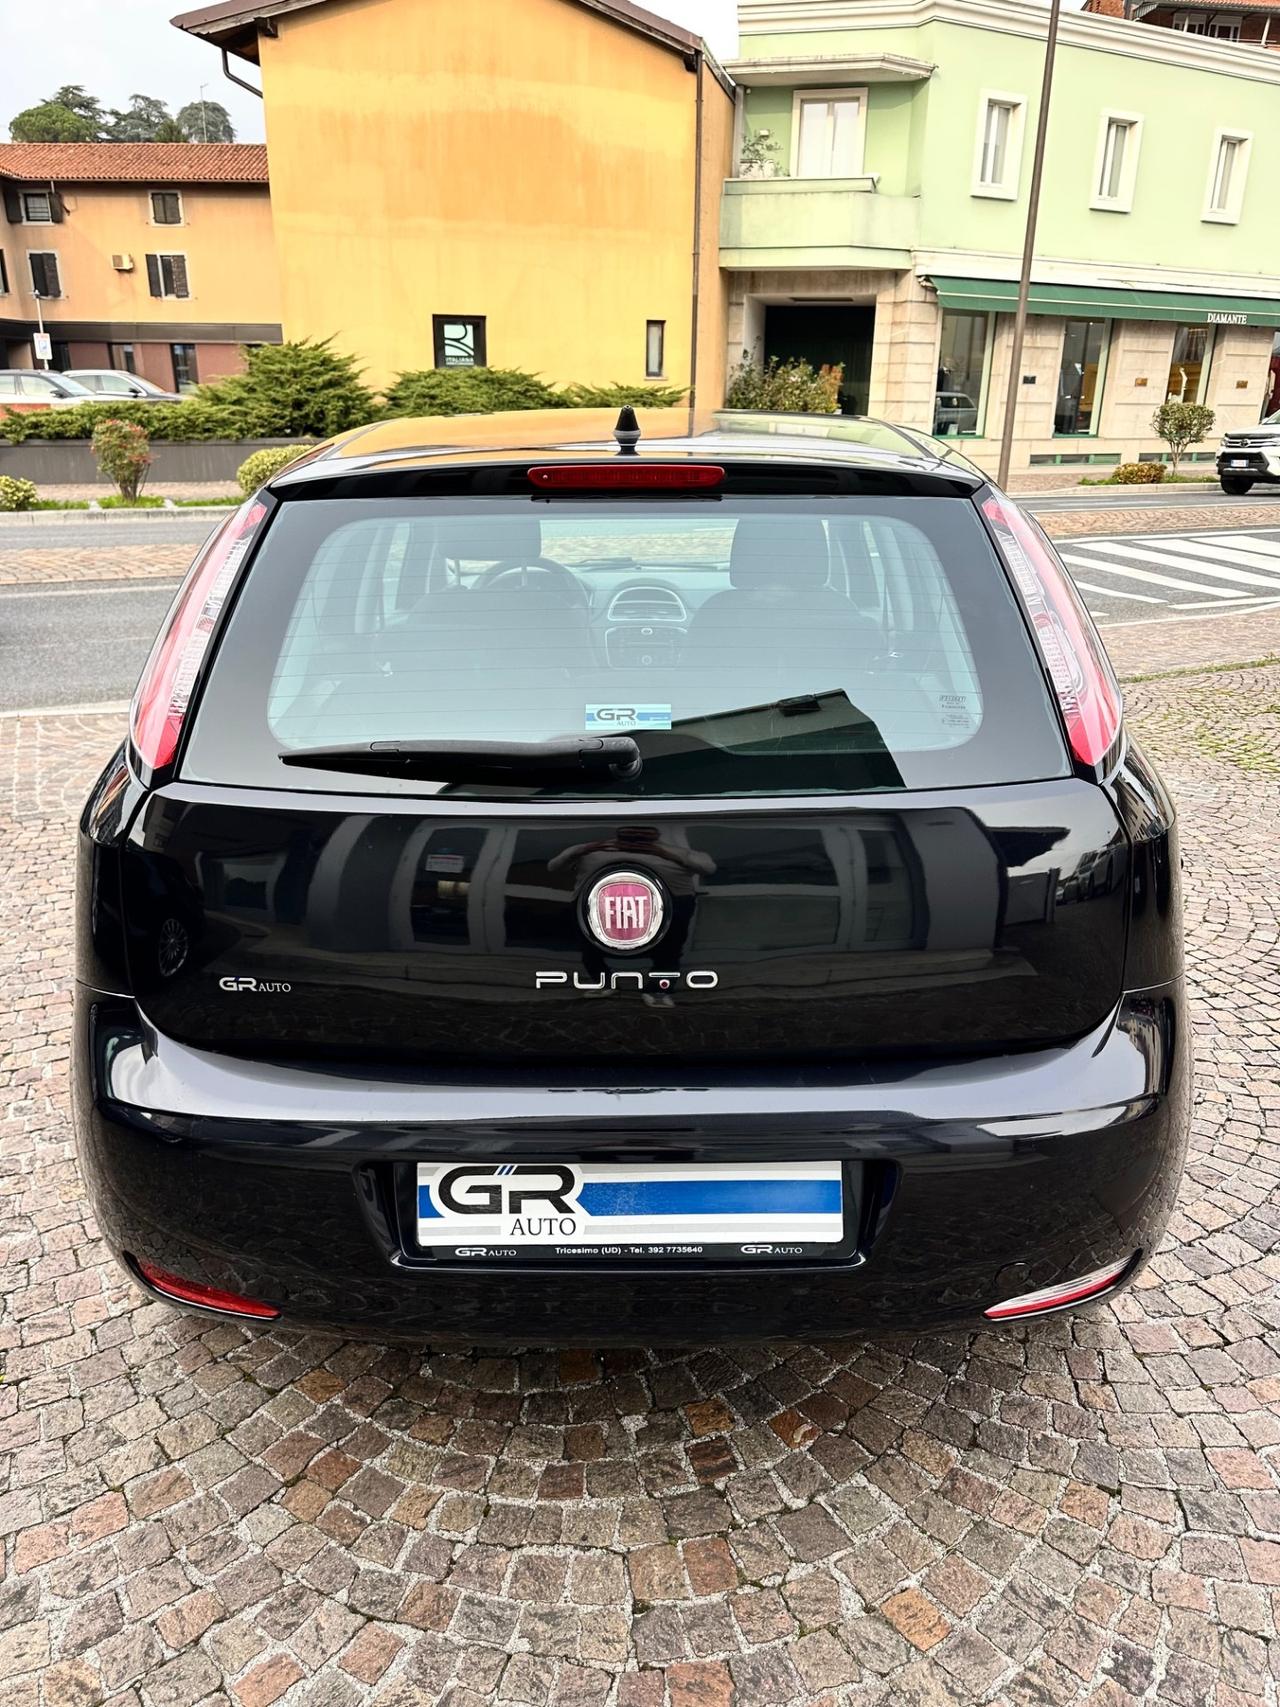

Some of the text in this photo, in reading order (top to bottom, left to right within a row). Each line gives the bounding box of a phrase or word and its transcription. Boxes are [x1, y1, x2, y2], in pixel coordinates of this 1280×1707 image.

[1207, 312, 1248, 325] DIAMANTE
[596, 708, 636, 721] GR
[604, 895, 648, 930] FIAT
[219, 976, 292, 993] GR AUTO
[535, 970, 719, 990] PUNTO
[438, 1164, 576, 1214] GR
[509, 1217, 577, 1236] AUTO
[454, 1247, 517, 1257] GR AUTO
[601, 1246, 621, 1256] (UD)
[629, 1246, 646, 1254] Tel.
[648, 1246, 664, 1254] 392
[665, 1246, 703, 1254] 7735640
[740, 1244, 773, 1254] GR
